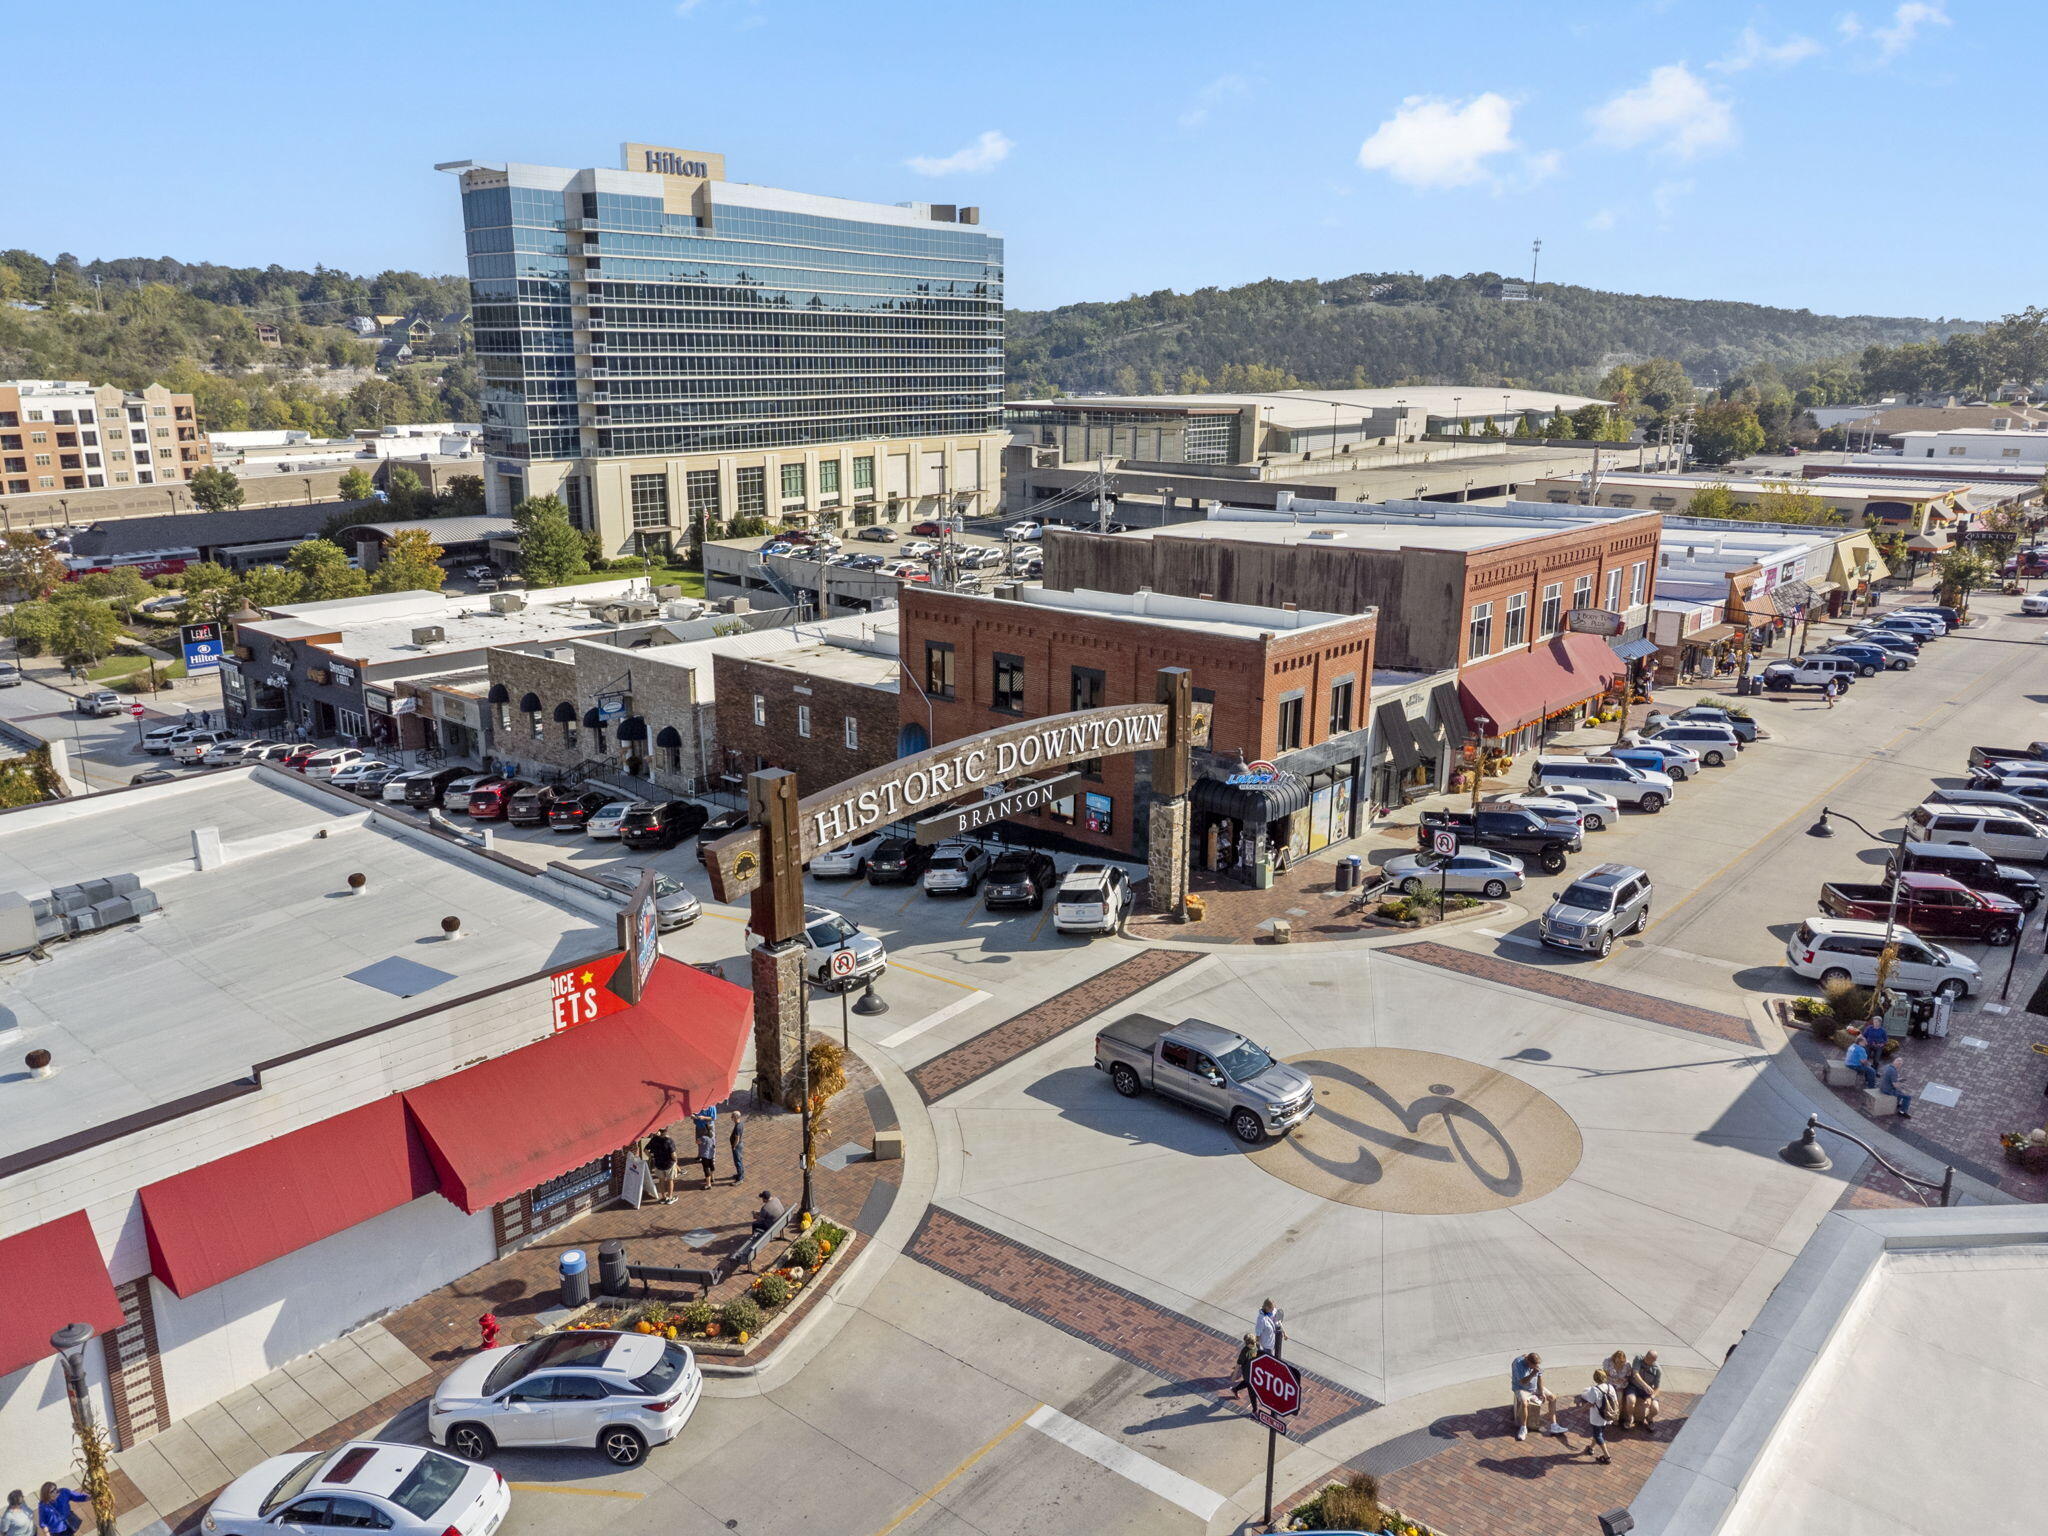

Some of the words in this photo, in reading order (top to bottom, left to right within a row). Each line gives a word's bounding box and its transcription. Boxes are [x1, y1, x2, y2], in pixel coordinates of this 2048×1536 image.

[645, 150, 708, 178] Hilton
[1972, 532, 2014, 540] PARKING
[814, 749, 986, 847] HISTORIC
[996, 714, 1163, 775] DOWNTOWN
[959, 785, 1054, 832] BRANSON
[554, 987, 597, 1029] ETS
[1253, 1366, 1296, 1401] STOP
